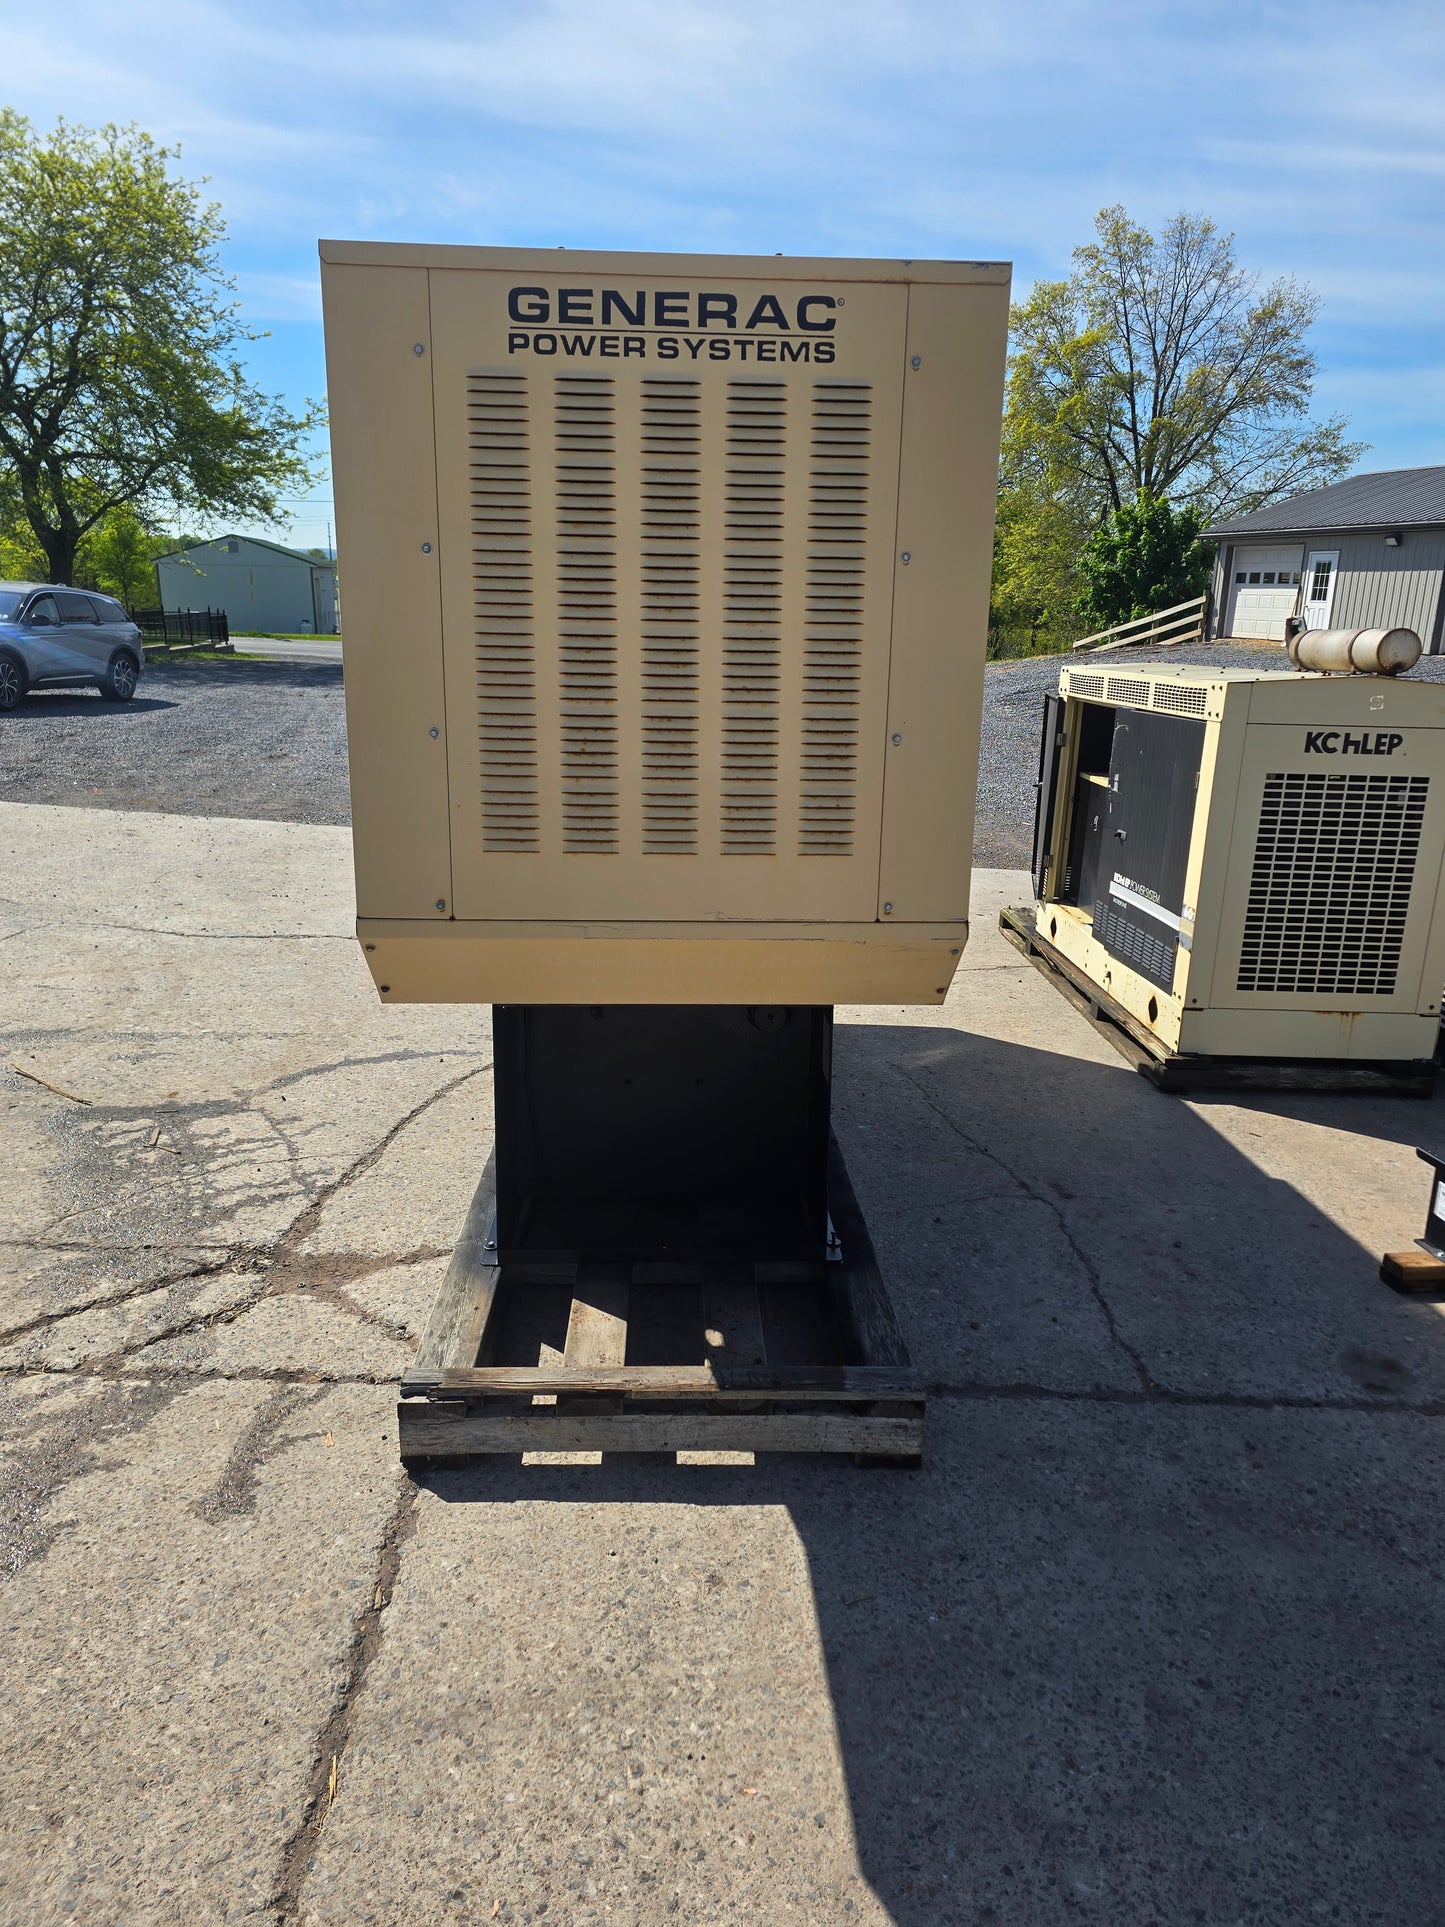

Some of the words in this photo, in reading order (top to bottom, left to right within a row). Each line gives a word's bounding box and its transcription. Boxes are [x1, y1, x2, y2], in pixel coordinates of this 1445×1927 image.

[508, 287, 837, 331] GENERAC
[508, 333, 646, 358] POWER
[657, 337, 836, 363] SYSTEMS
